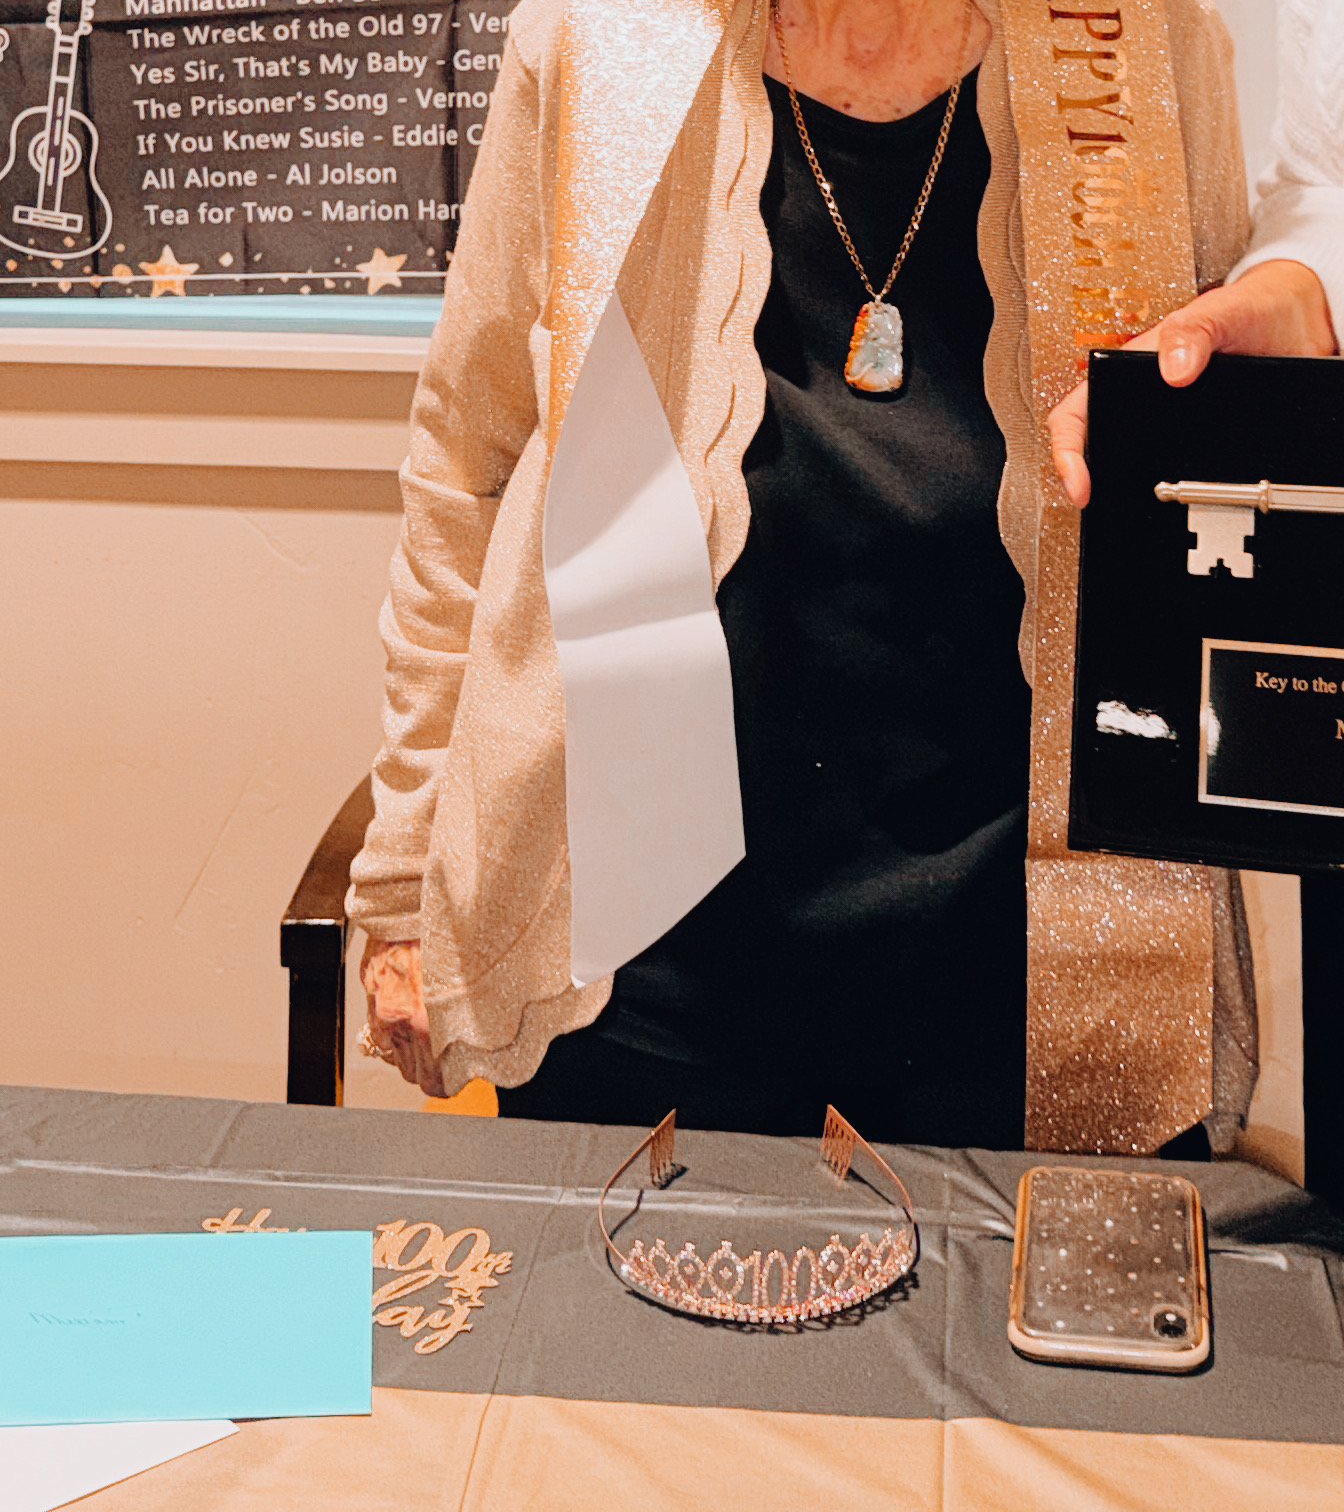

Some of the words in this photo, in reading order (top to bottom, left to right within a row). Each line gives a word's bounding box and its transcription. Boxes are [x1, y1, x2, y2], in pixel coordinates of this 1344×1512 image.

[142, 162, 174, 190] All
[183, 162, 258, 189] Alone
[285, 163, 312, 187] Al
[318, 162, 397, 186] Jolson
[1254, 671, 1288, 696] Key
[1292, 674, 1309, 692] to
[1312, 676, 1337, 694] the
